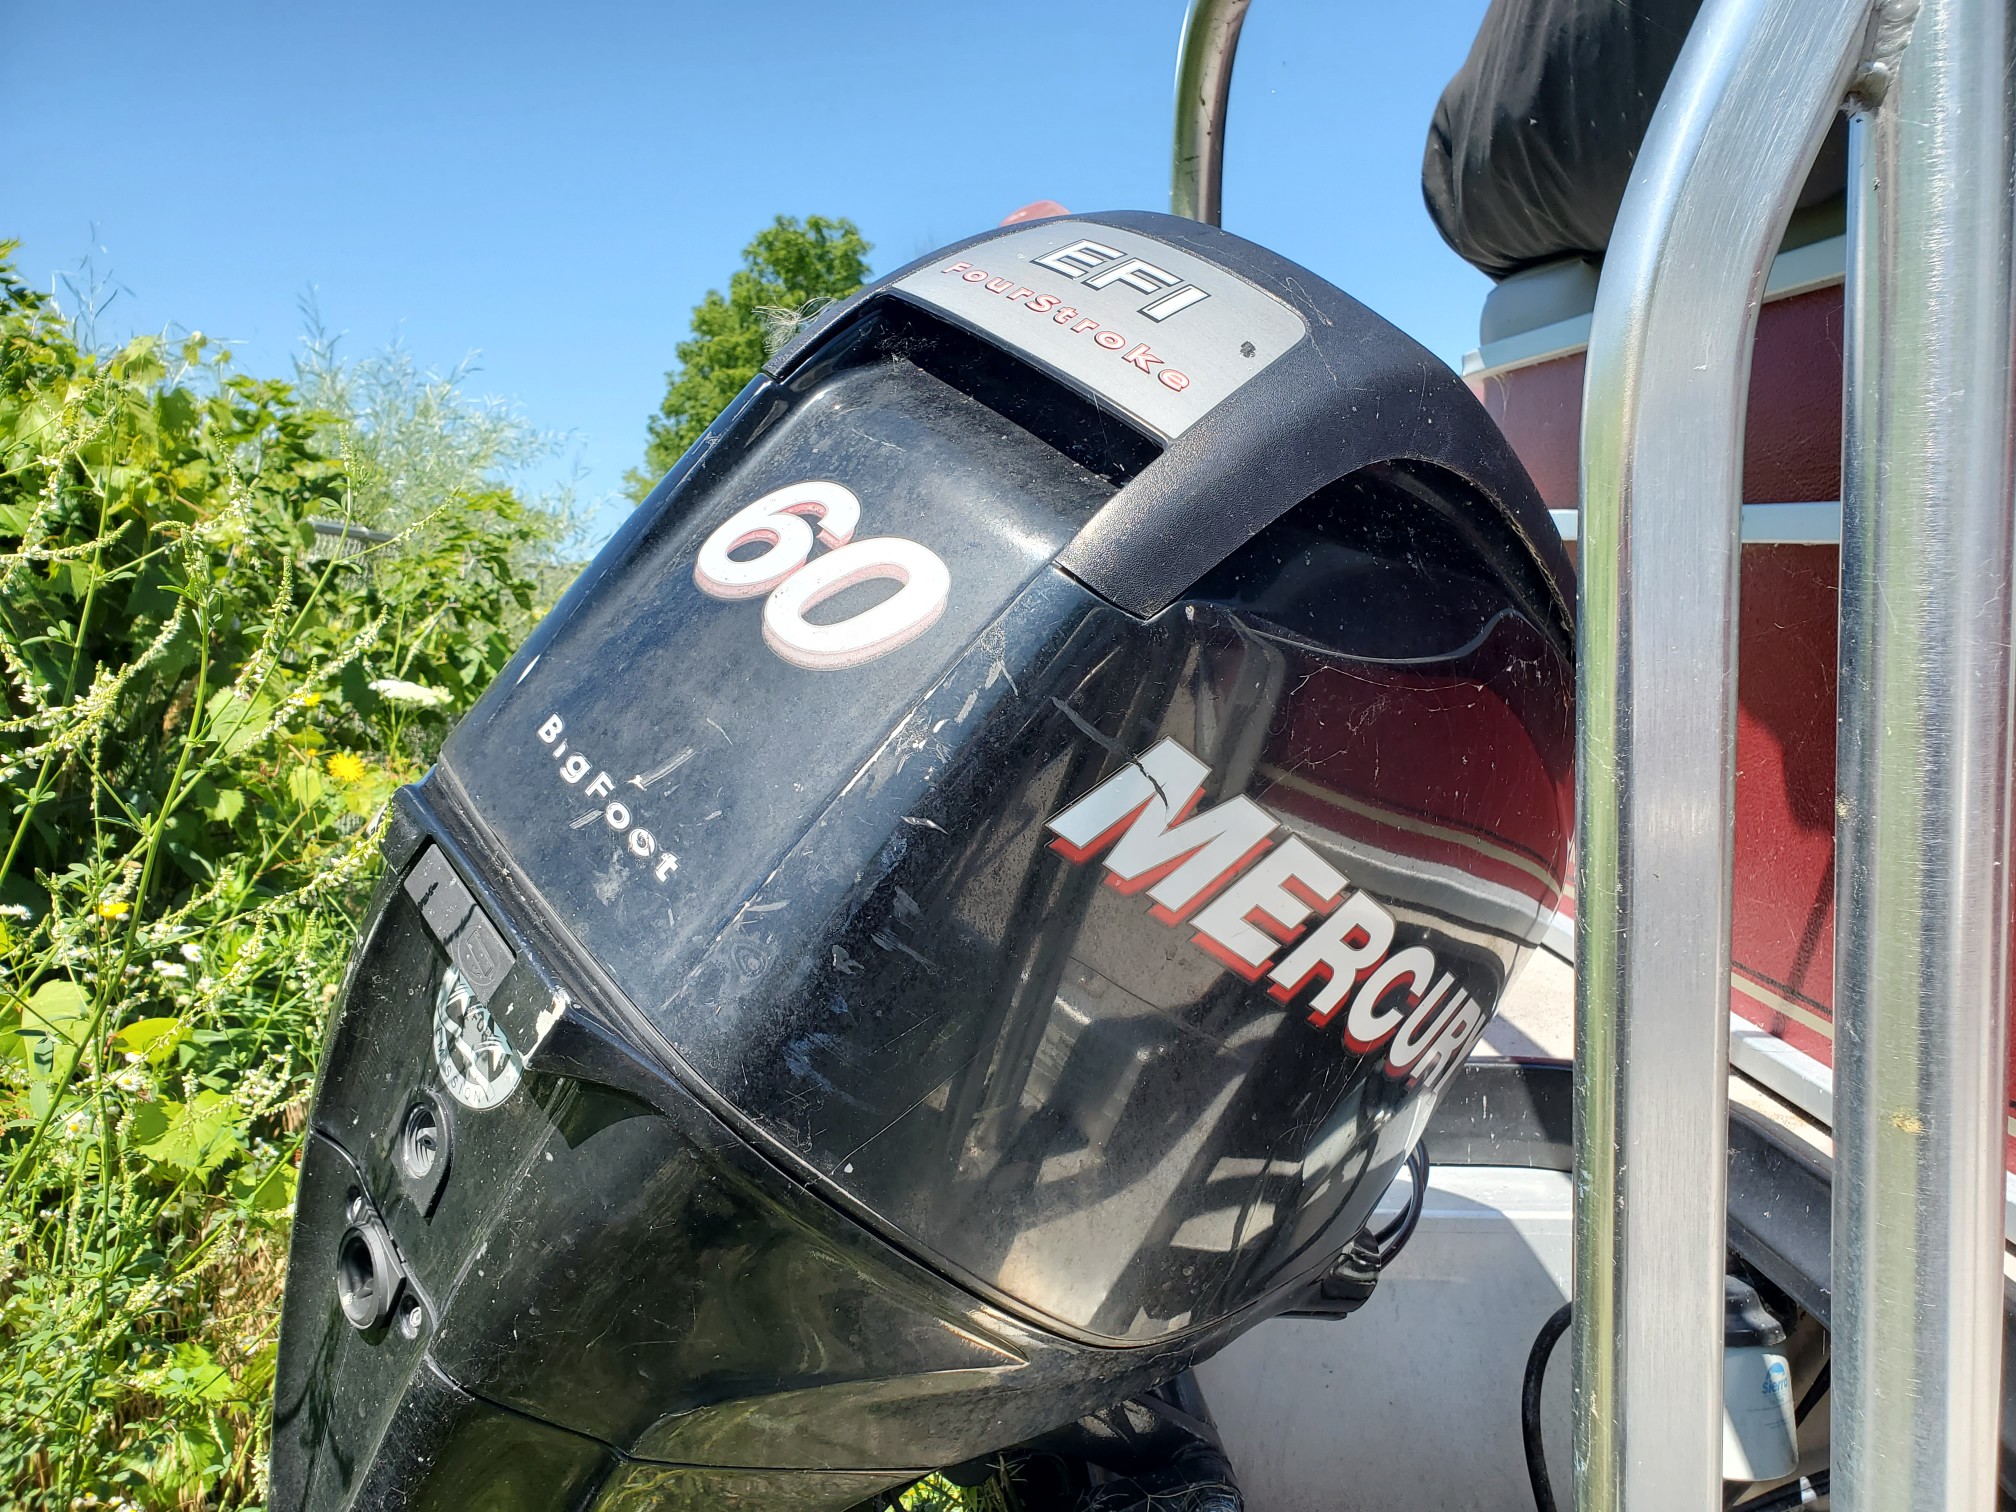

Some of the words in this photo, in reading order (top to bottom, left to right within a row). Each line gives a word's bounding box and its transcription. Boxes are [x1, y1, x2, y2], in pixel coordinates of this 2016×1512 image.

[941, 261, 1190, 392] FourStroke
[1030, 238, 1212, 323] EFI
[693, 480, 952, 671] 60
[536, 713, 681, 883] BigFoot
